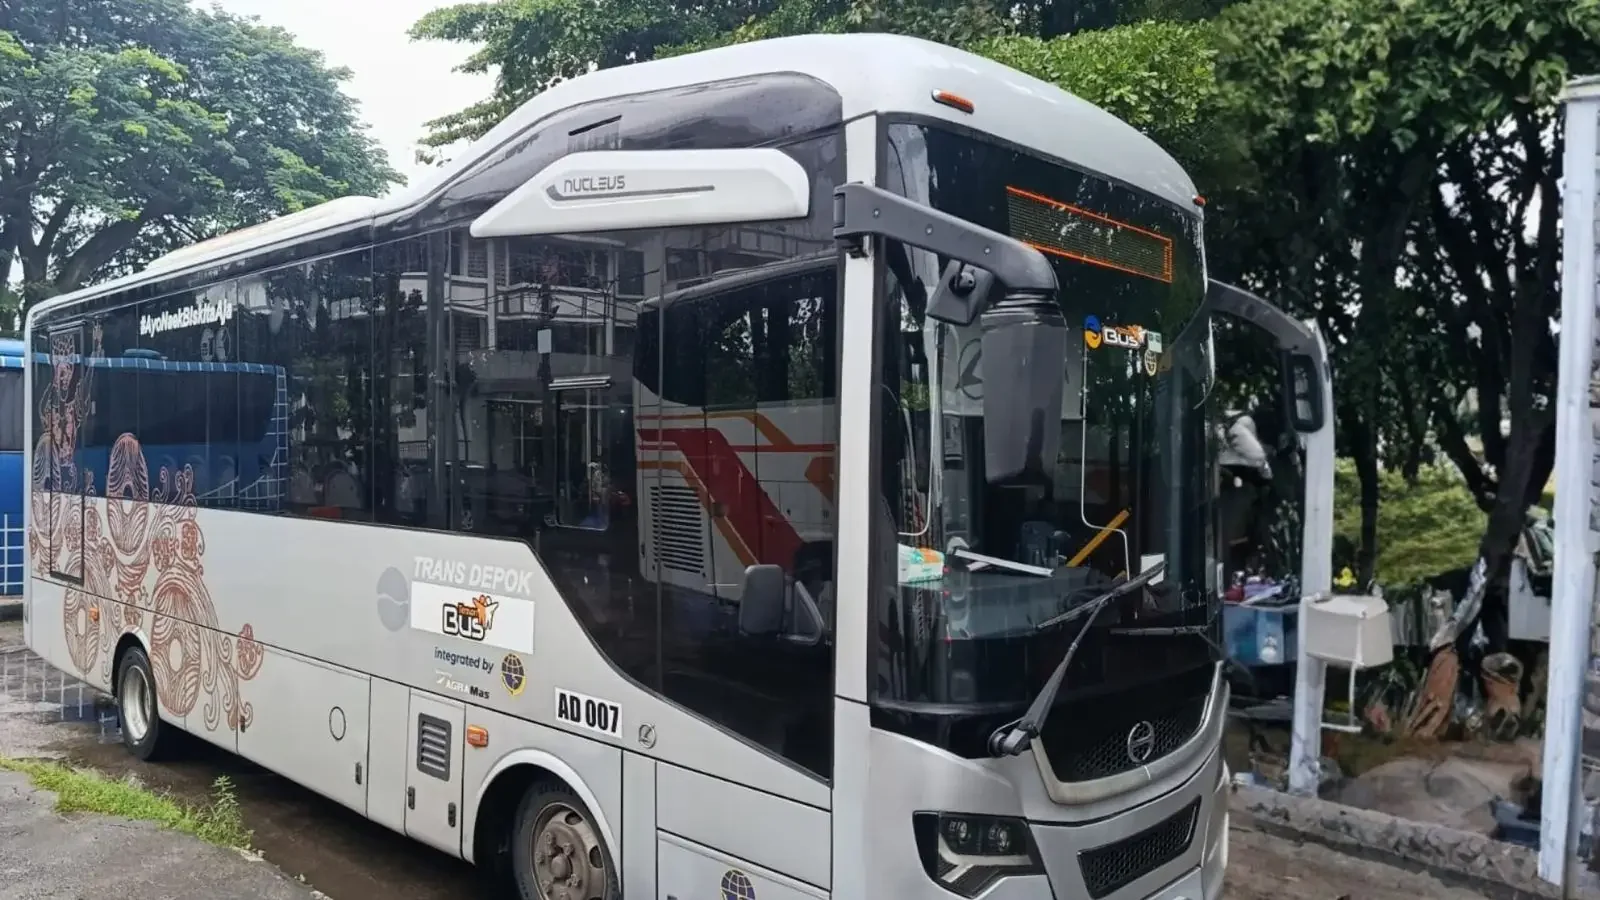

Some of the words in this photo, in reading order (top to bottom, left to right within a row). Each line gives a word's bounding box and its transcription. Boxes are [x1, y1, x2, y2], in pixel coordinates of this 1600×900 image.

[563, 175, 626, 193] NUCLEUS
[413, 556, 465, 586] TRANS
[468, 565, 534, 595] DEPOK
[434, 646, 481, 668] integrated
[482, 658, 495, 674] by
[557, 692, 582, 724] AD
[584, 698, 619, 733] 007
